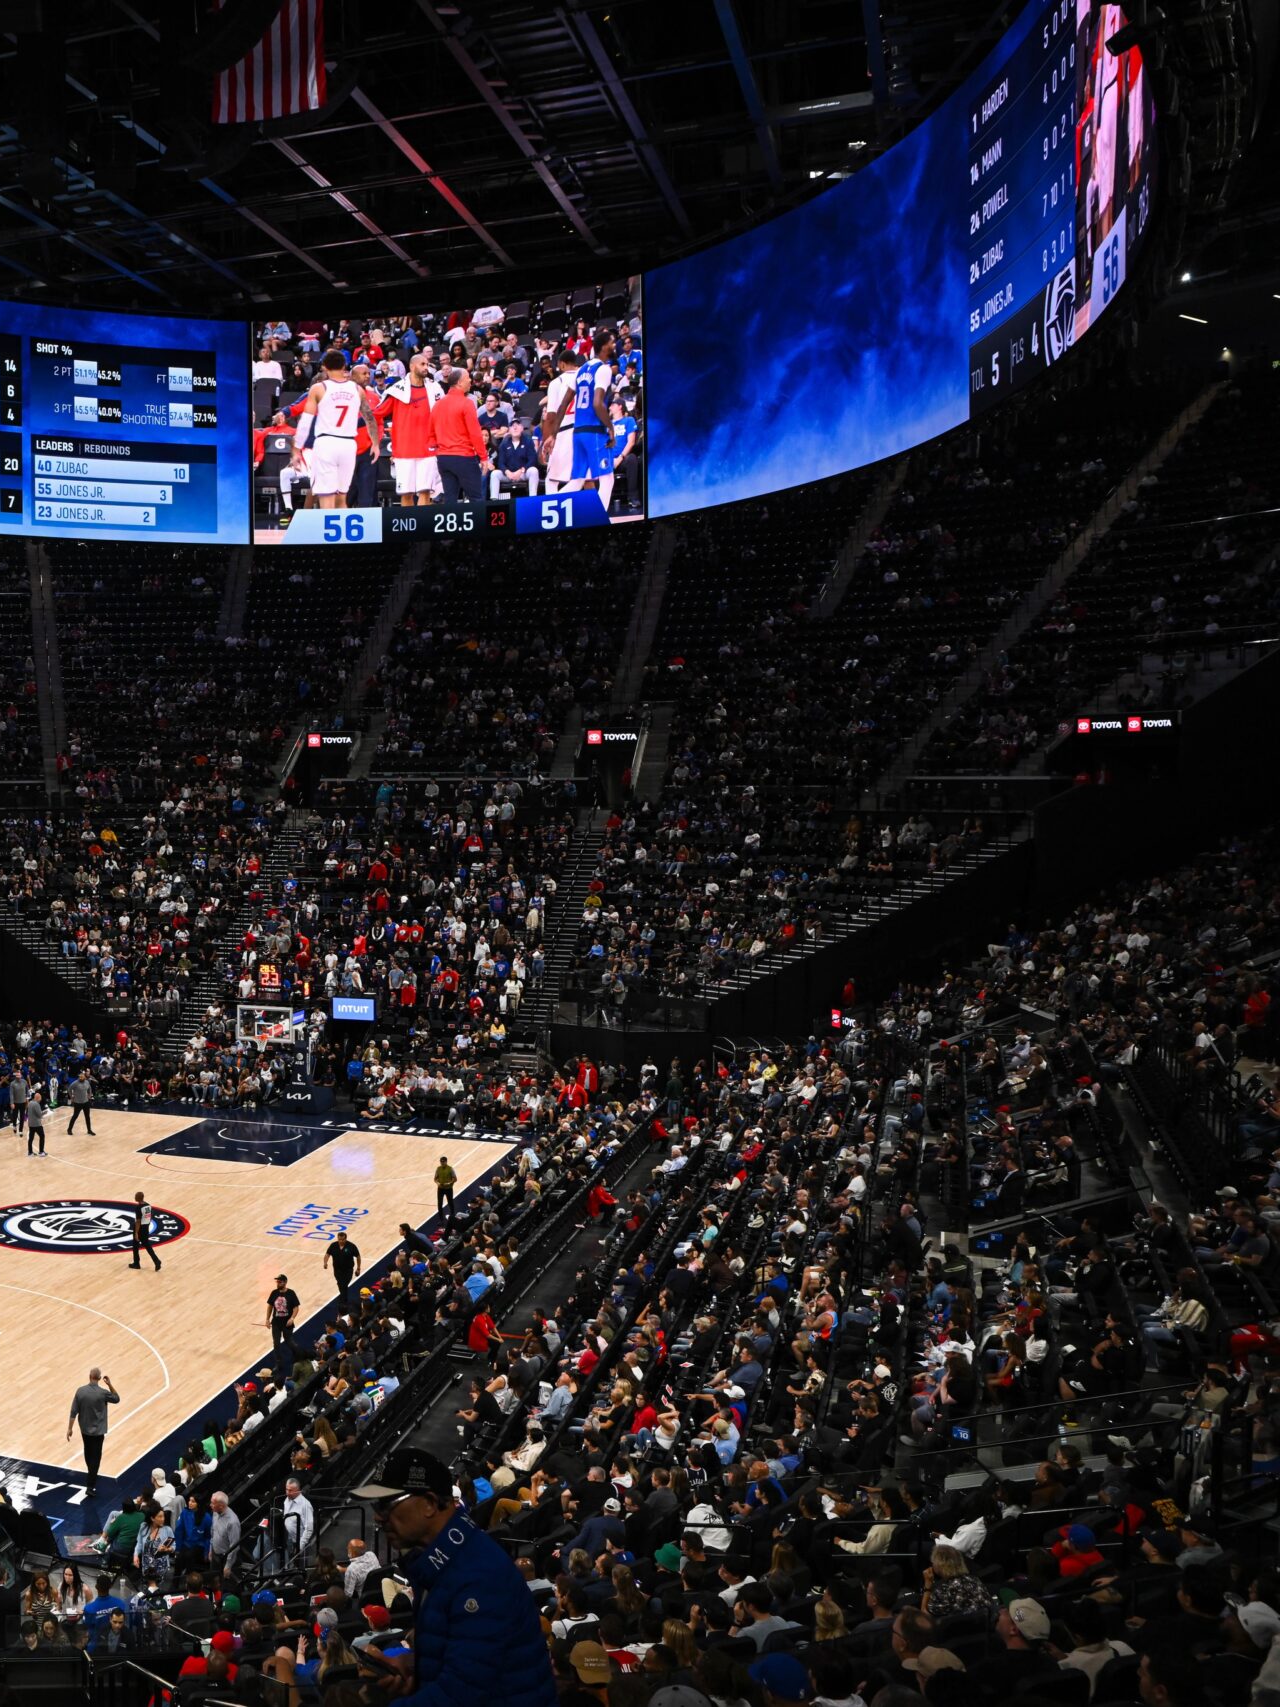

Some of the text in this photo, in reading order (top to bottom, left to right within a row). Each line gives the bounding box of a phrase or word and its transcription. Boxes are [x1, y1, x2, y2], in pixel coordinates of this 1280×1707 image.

[982, 78, 1009, 124] HARDEN
[982, 138, 1002, 175] MANN
[982, 184, 1009, 224] POWELL
[982, 239, 1004, 275] ZUBAC
[1102, 234, 1118, 304] 56
[982, 290, 1004, 324] JONES
[36, 342, 58, 354] SHOT
[145, 404, 167, 414] TRUE
[122, 415, 167, 426] SHOOTING
[36, 439, 130, 456] LEADERS REBOUNDS
[4, 458, 18, 470] 20
[38, 460, 185, 479] 40 ZUBAC 10
[38, 483, 88, 498] 55 JONES
[38, 505, 88, 520] 23 JONES
[324, 498, 573, 543] 56 2ND 28.5 23 51
[1091, 721, 1122, 729] TOYOTA
[1143, 719, 1172, 728] TOYOTA
[322, 736, 352, 744] TOYOTA
[603, 732, 637, 741] TOYOTA
[338, 1004, 369, 1014] INTUIT
[321, 1120, 357, 1129] LA
[368, 1124, 523, 1140] CLIPPERS
[266, 1203, 331, 1236] INTUIT
[25, 1474, 89, 1505] LA
